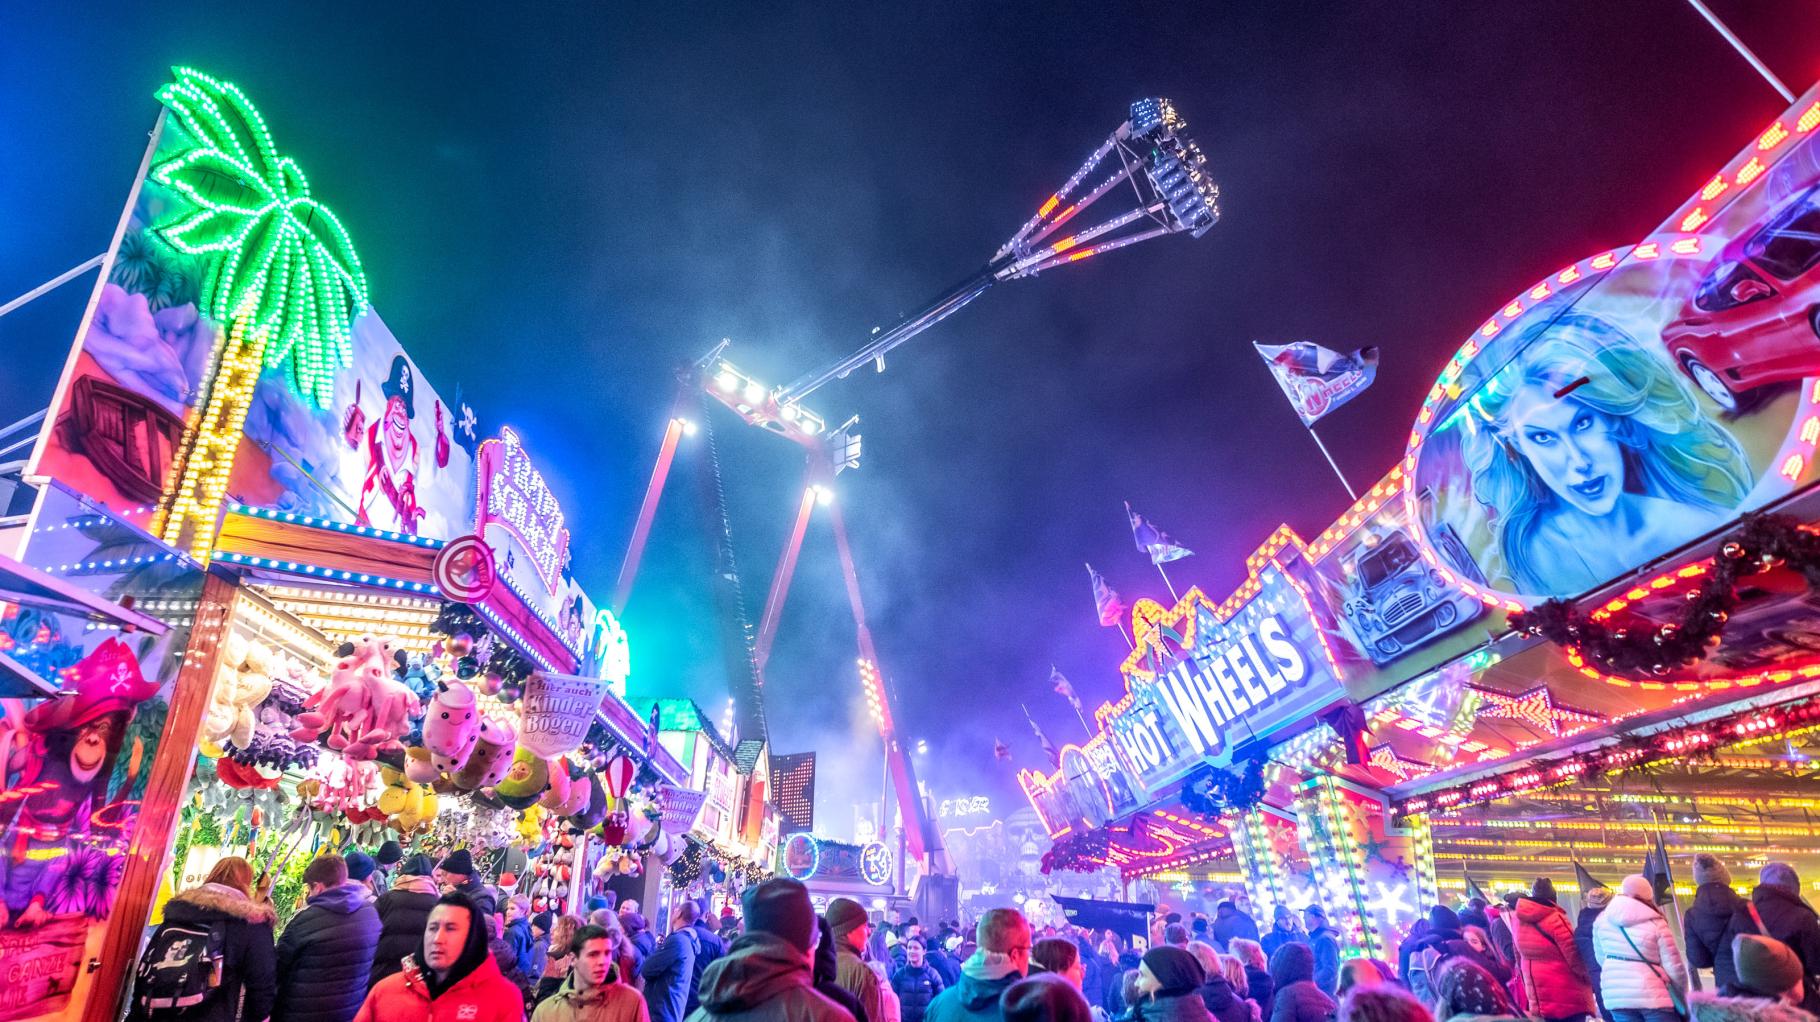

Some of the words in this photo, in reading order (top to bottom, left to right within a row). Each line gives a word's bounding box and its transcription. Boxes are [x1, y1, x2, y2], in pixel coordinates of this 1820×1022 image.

[564, 686, 592, 697] auch
[1120, 708, 1173, 775] HOT
[1156, 617, 1305, 756] WHEELS
[527, 694, 596, 718] Kinder-
[525, 714, 584, 737] Bögen
